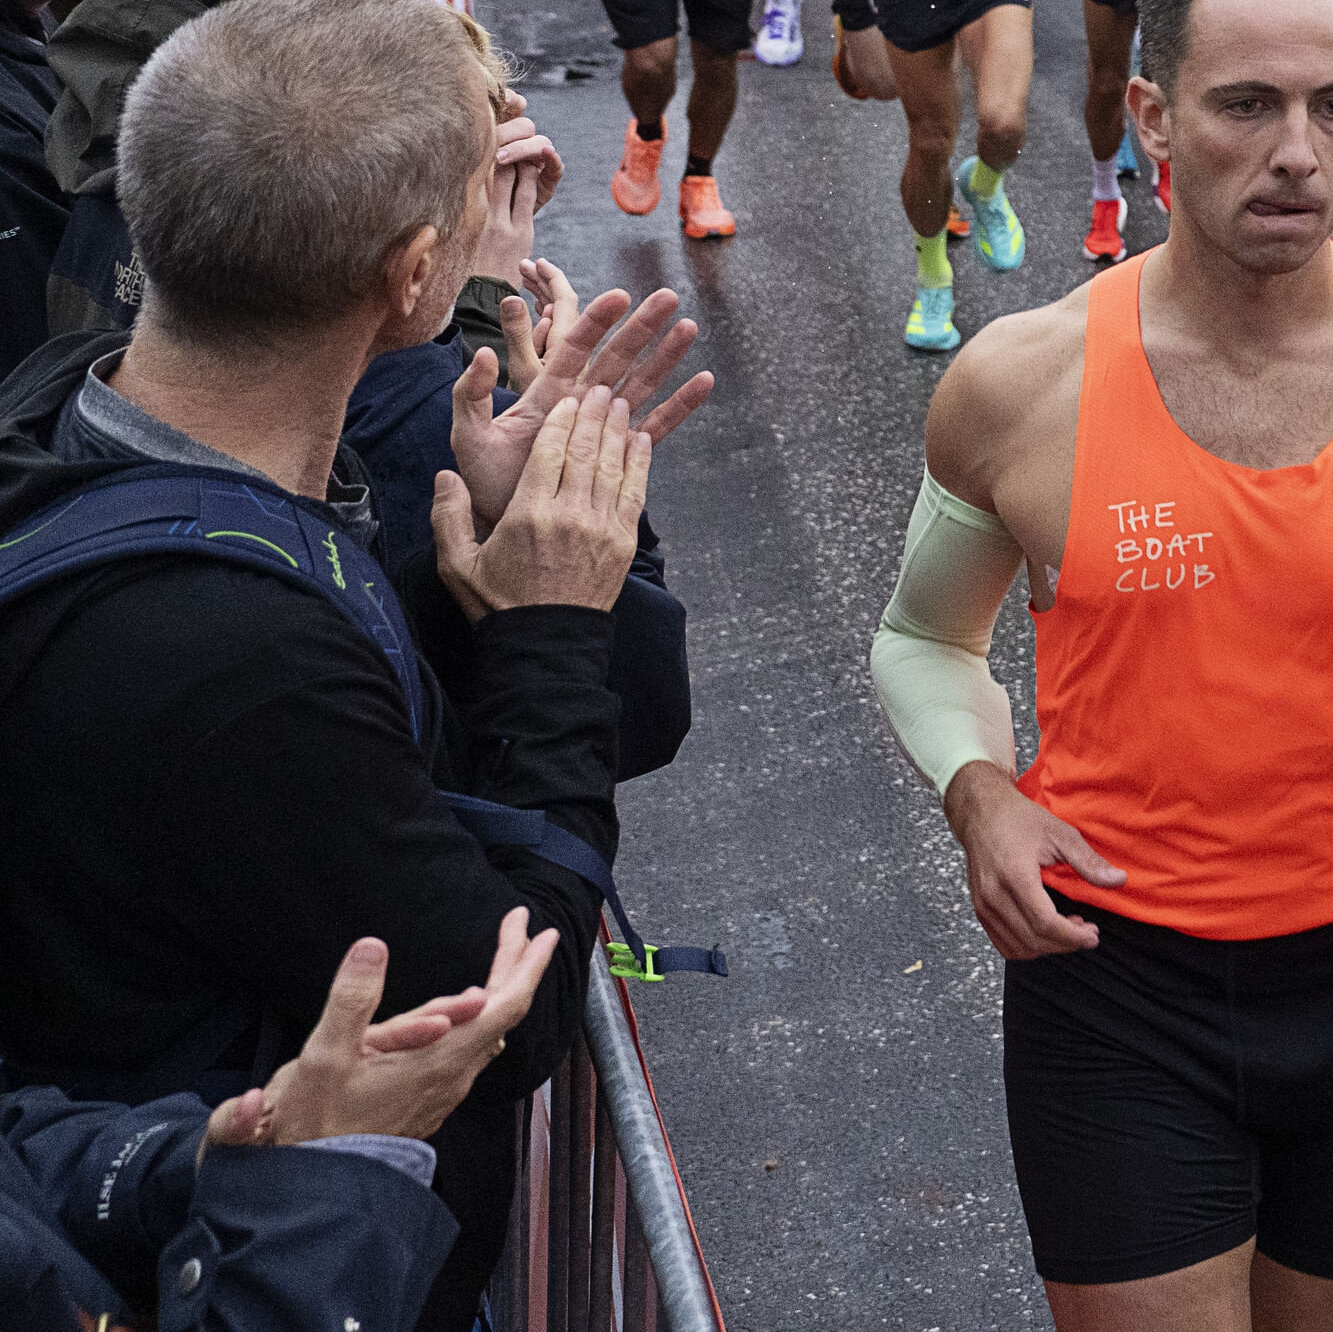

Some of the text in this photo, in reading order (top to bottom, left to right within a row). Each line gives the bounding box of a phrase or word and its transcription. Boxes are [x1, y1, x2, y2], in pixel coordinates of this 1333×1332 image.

[1107, 499, 1176, 534] THE
[1114, 532, 1214, 563] BOAT
[1115, 563, 1216, 593] CLUB
